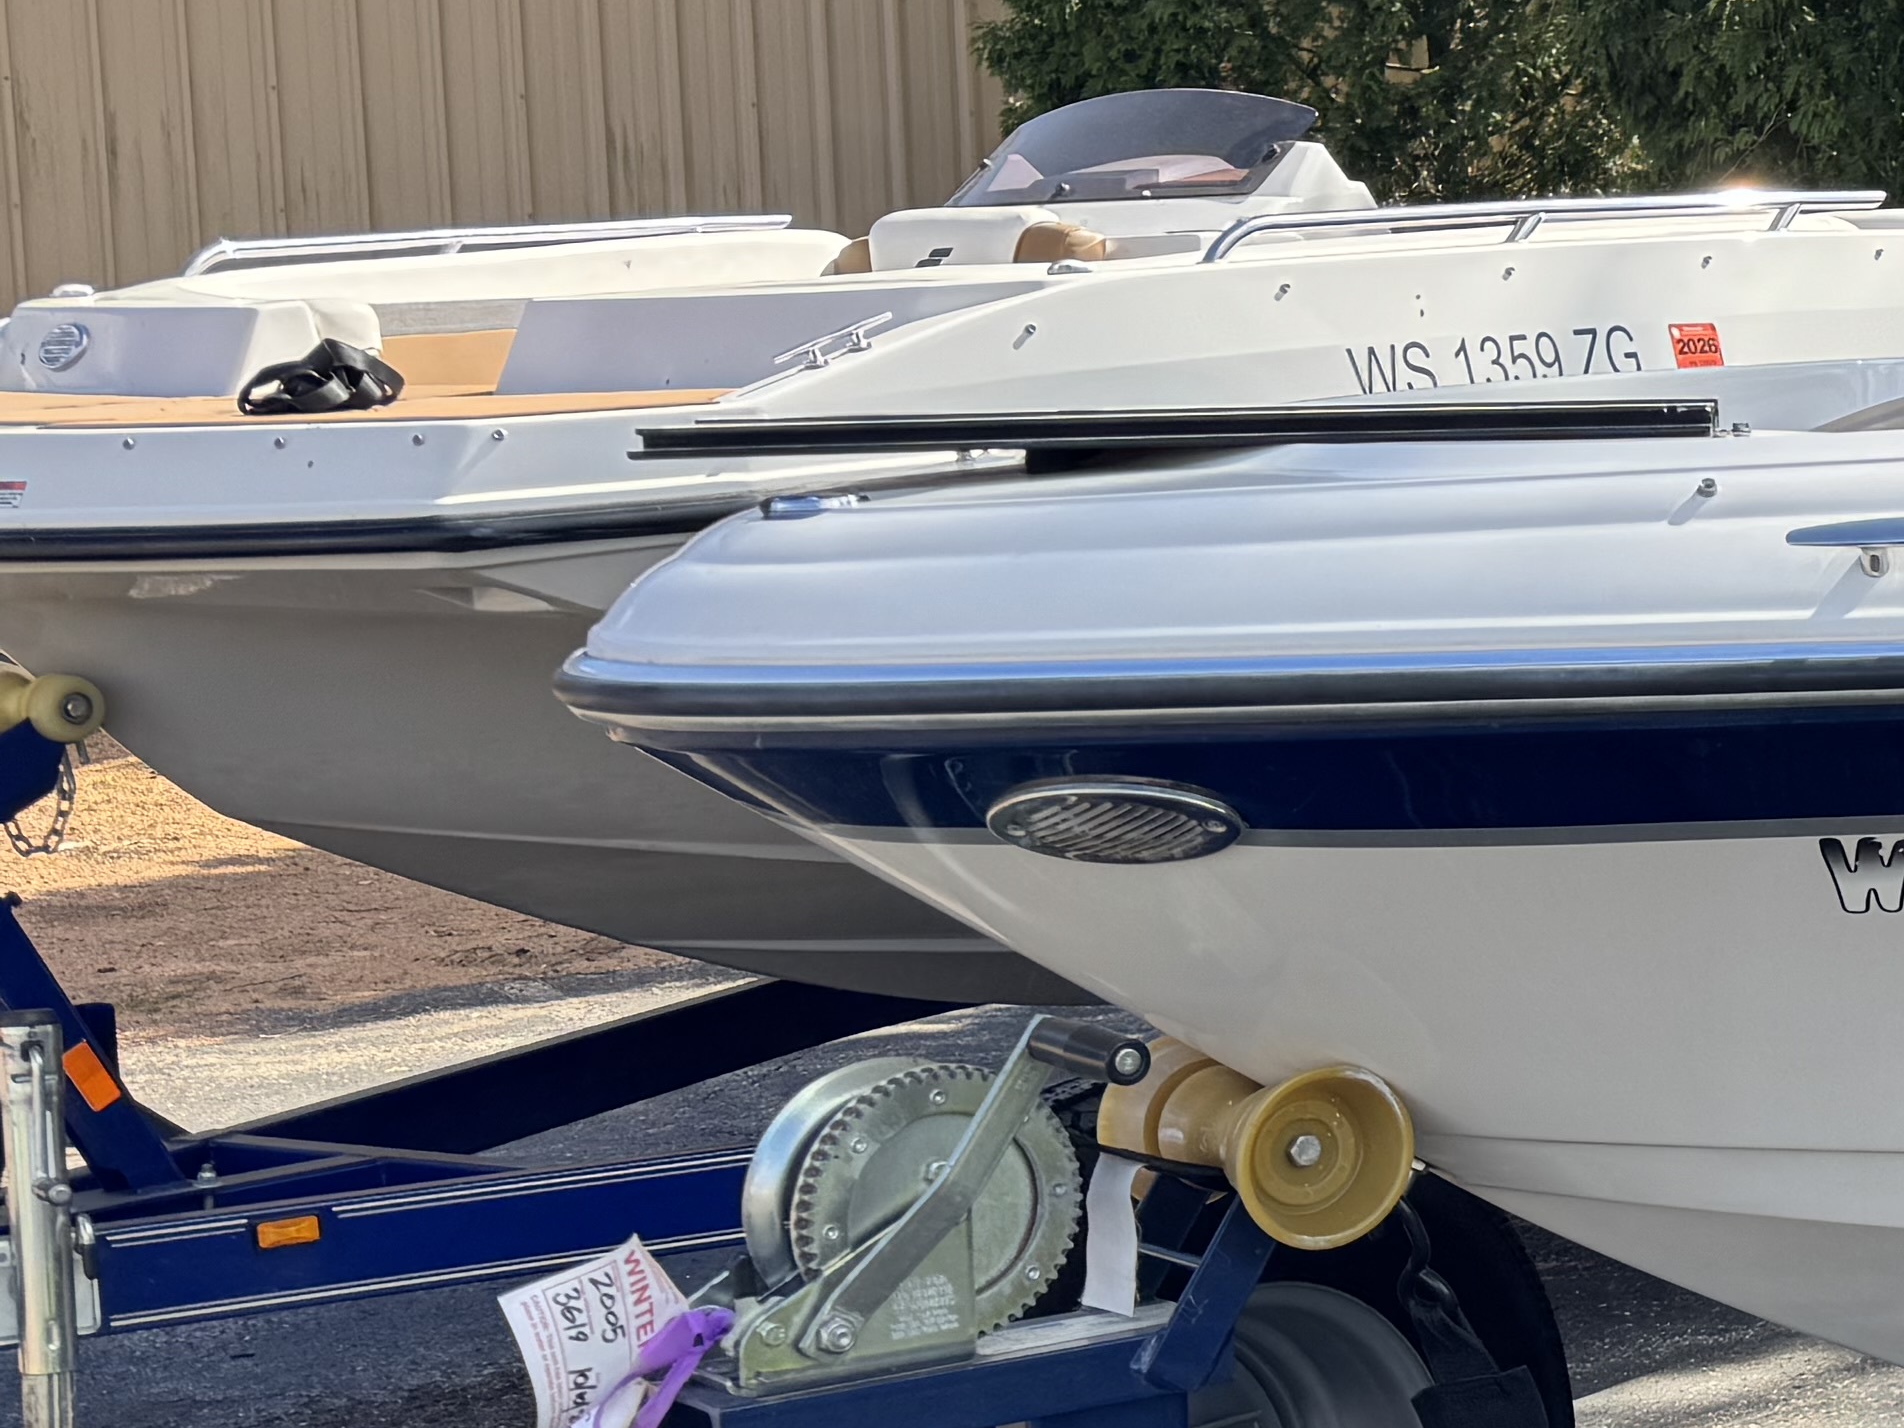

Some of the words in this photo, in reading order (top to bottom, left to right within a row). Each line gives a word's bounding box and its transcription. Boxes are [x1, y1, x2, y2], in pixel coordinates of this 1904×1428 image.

[1345, 341, 1437, 394] WS
[1455, 331, 1563, 384] 1359
[1675, 337, 1718, 355] 2026
[588, 1271, 626, 1344] 2005
